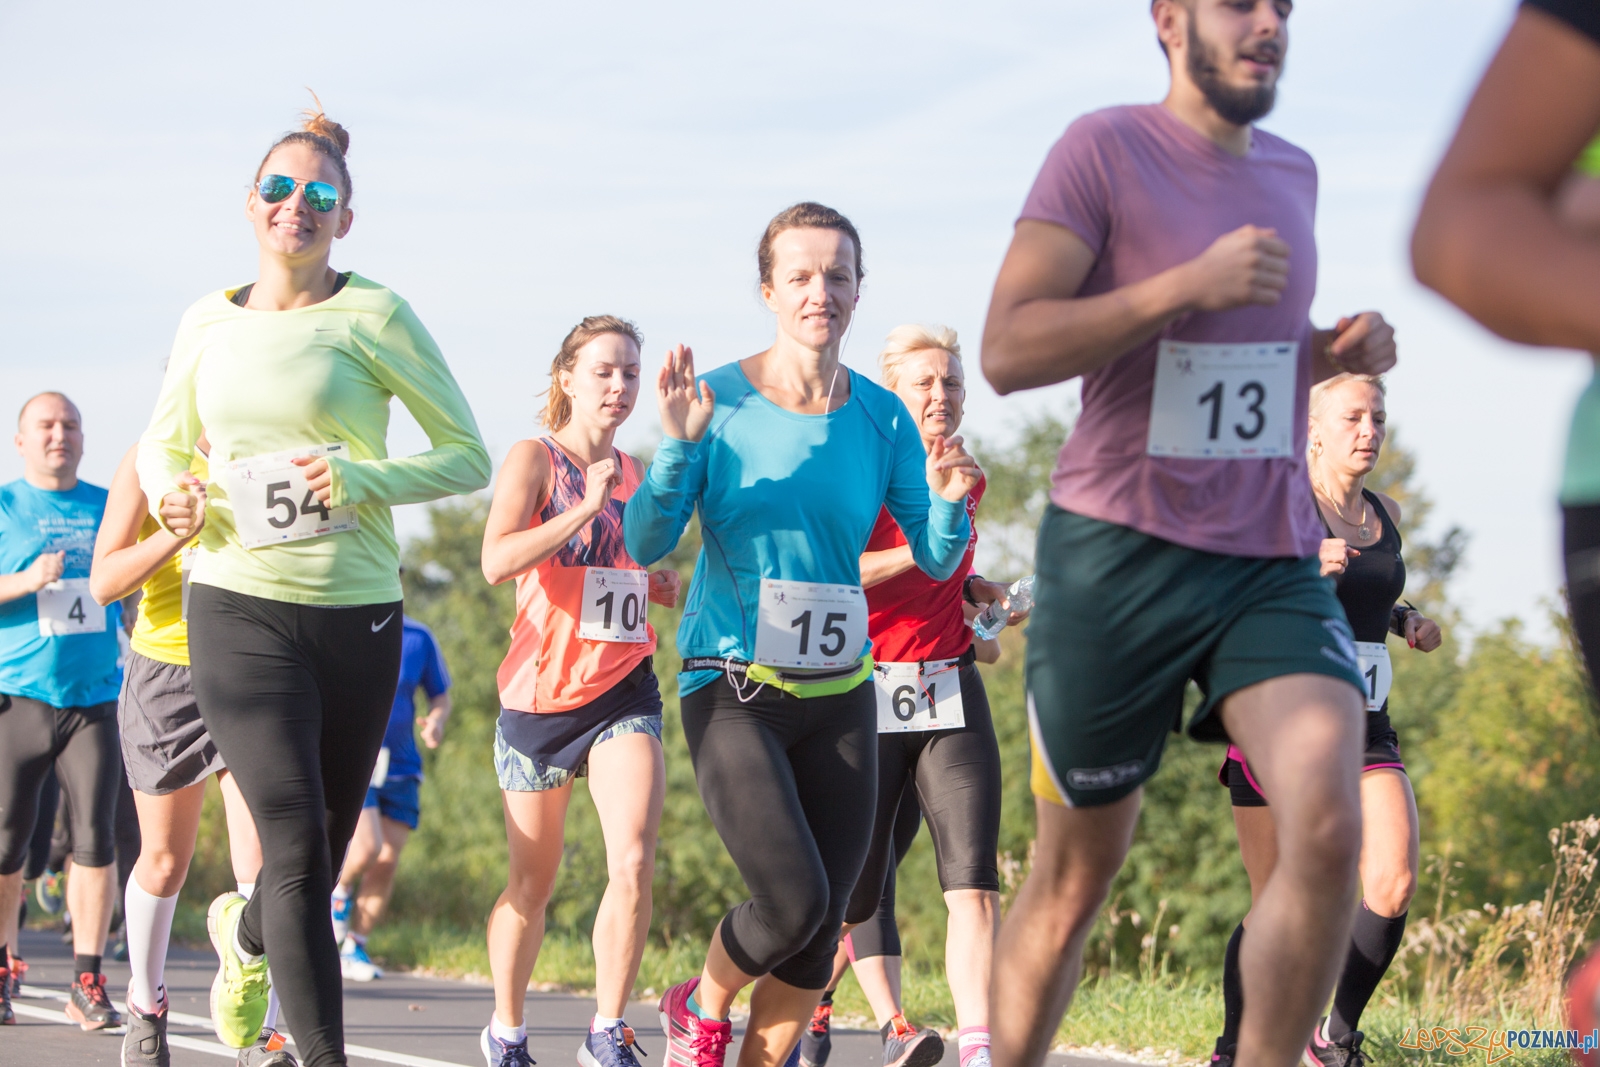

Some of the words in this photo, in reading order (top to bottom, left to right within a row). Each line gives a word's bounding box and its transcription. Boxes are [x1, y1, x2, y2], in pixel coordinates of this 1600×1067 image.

[1198, 380, 1266, 441] 13
[266, 480, 332, 529] 54
[68, 597, 86, 624] 4
[595, 591, 646, 632] 104
[791, 610, 847, 656] 15
[892, 682, 937, 722] 61
